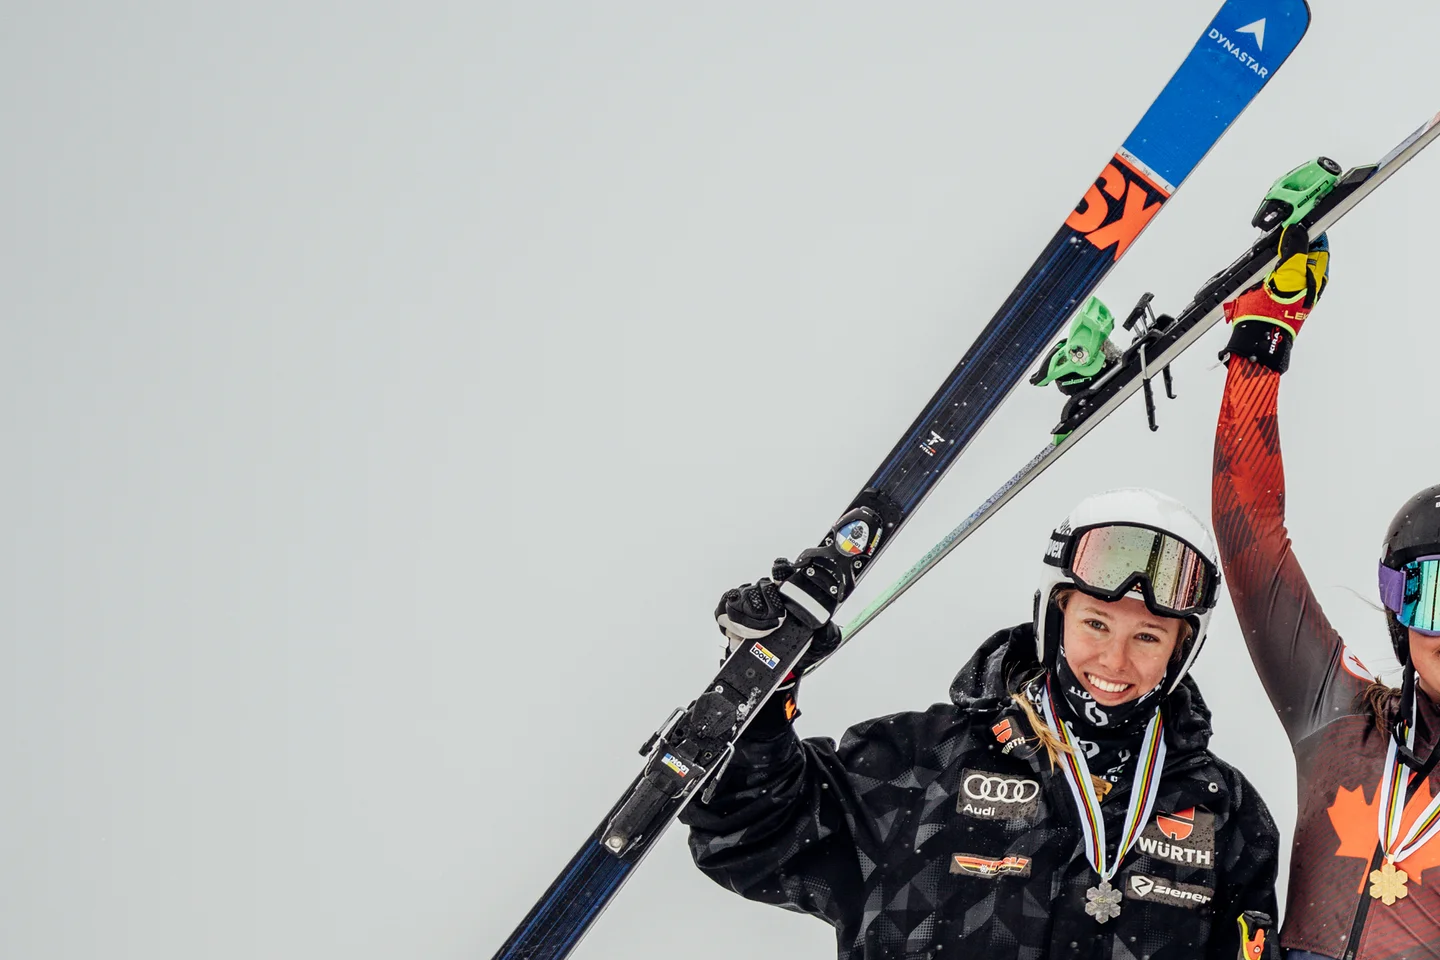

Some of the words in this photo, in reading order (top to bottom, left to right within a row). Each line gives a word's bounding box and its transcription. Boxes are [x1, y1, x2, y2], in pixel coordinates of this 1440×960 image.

[1208, 28, 1268, 79] DYNASTAR
[1064, 163, 1163, 262] SX
[751, 647, 770, 662] LOOK
[963, 802, 995, 817] Audi
